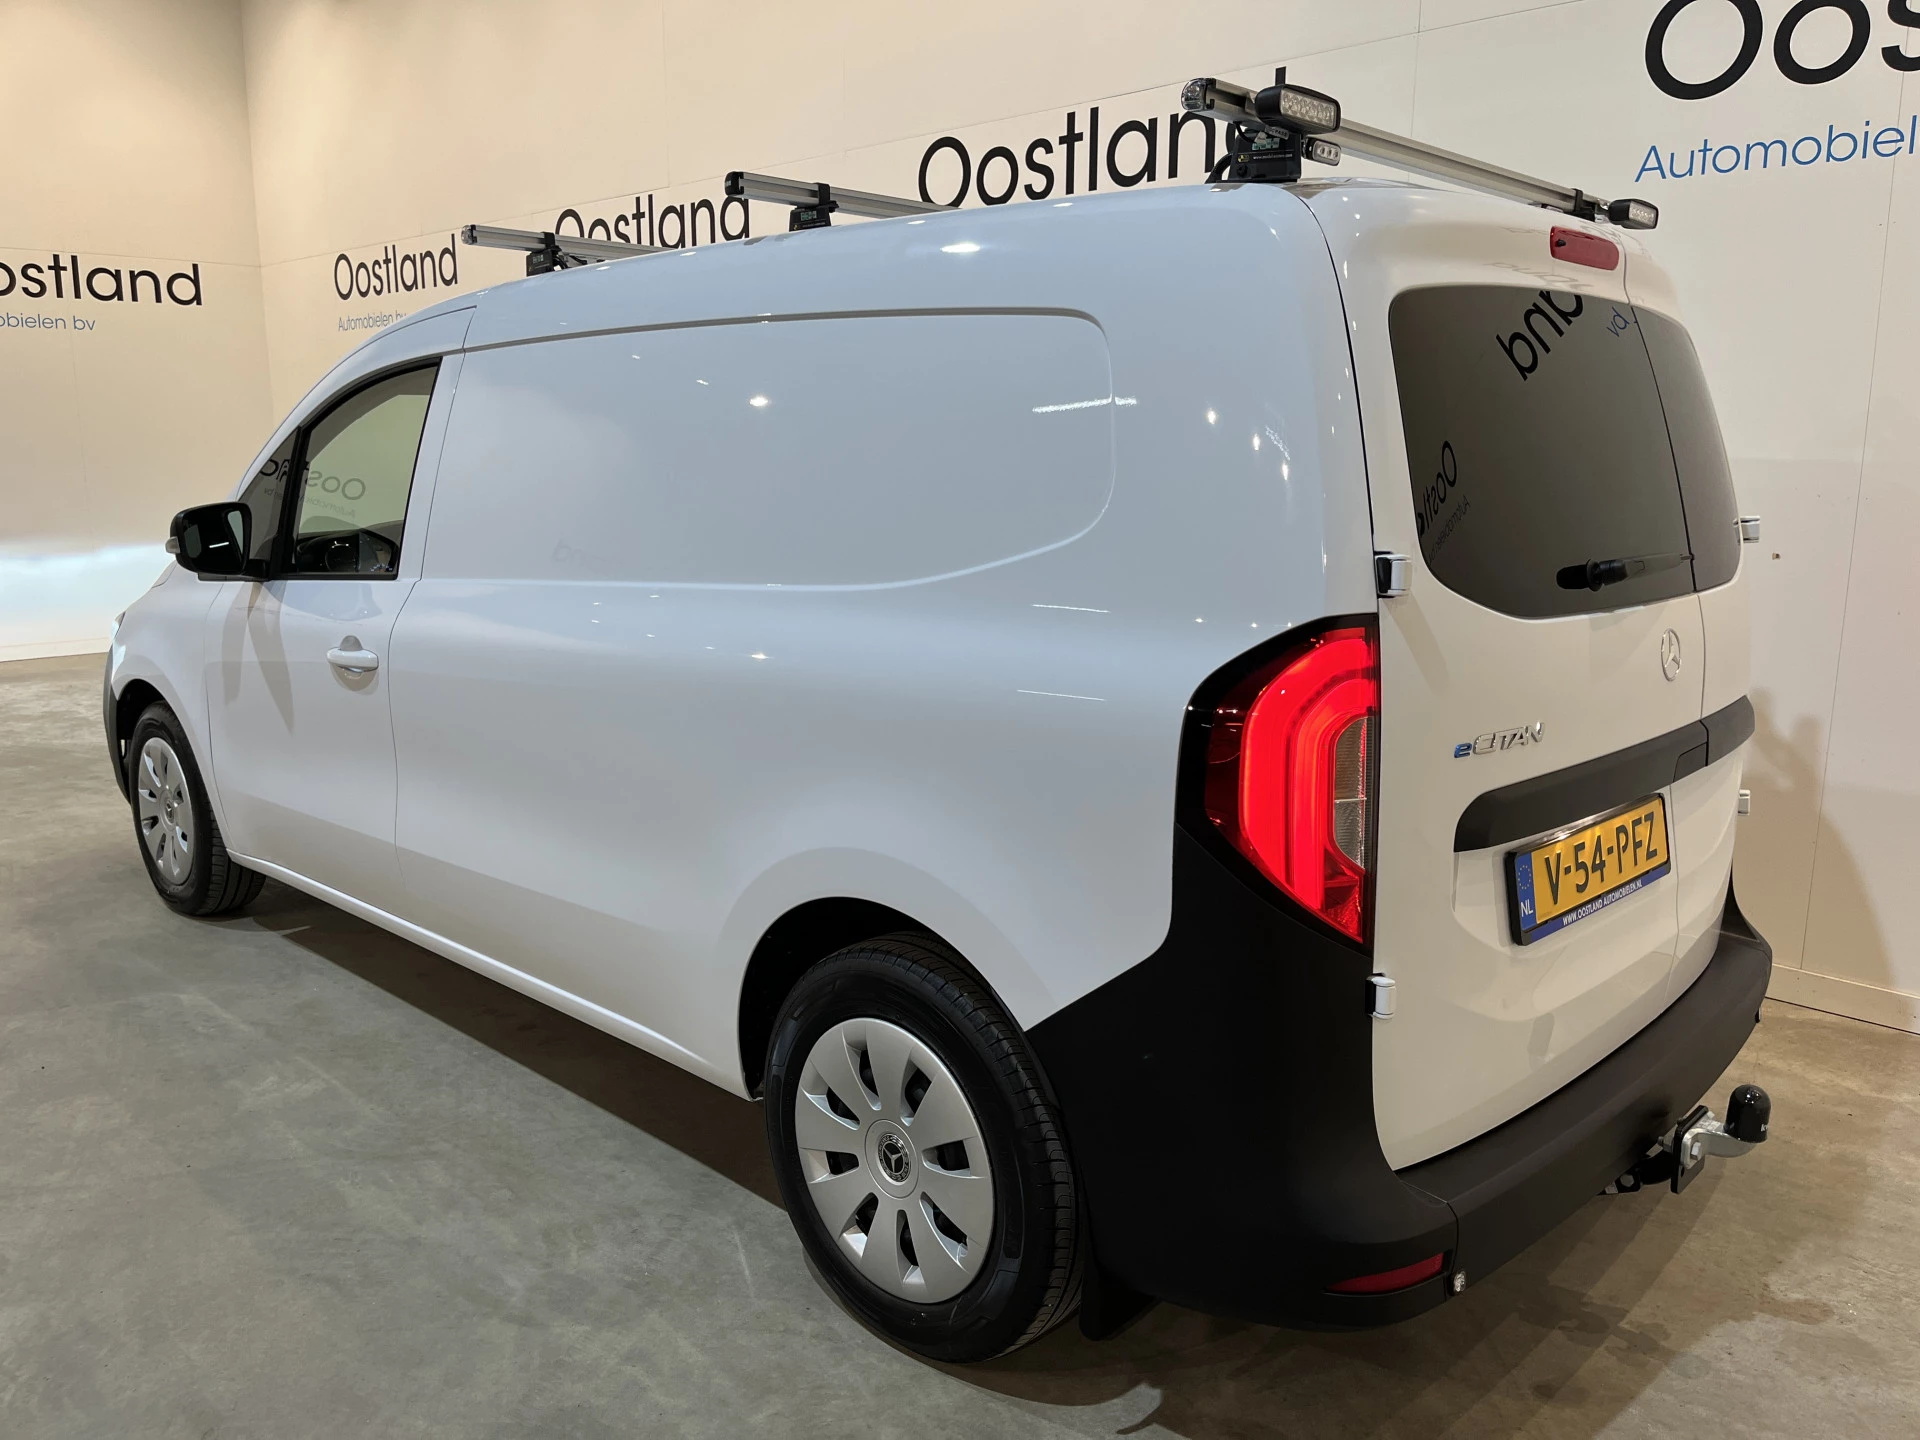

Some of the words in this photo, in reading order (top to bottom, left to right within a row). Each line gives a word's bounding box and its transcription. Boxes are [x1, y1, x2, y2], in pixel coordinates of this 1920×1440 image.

[918, 67, 1286, 207] Oostlan
[1635, 115, 1918, 182] Automobiel
[334, 233, 458, 300] Oostland
[73, 316, 96, 330] bv
[337, 311, 394, 332] Automobielen
[1545, 811, 1657, 905] V-54-PFZ
[1520, 899, 1533, 917] NL
